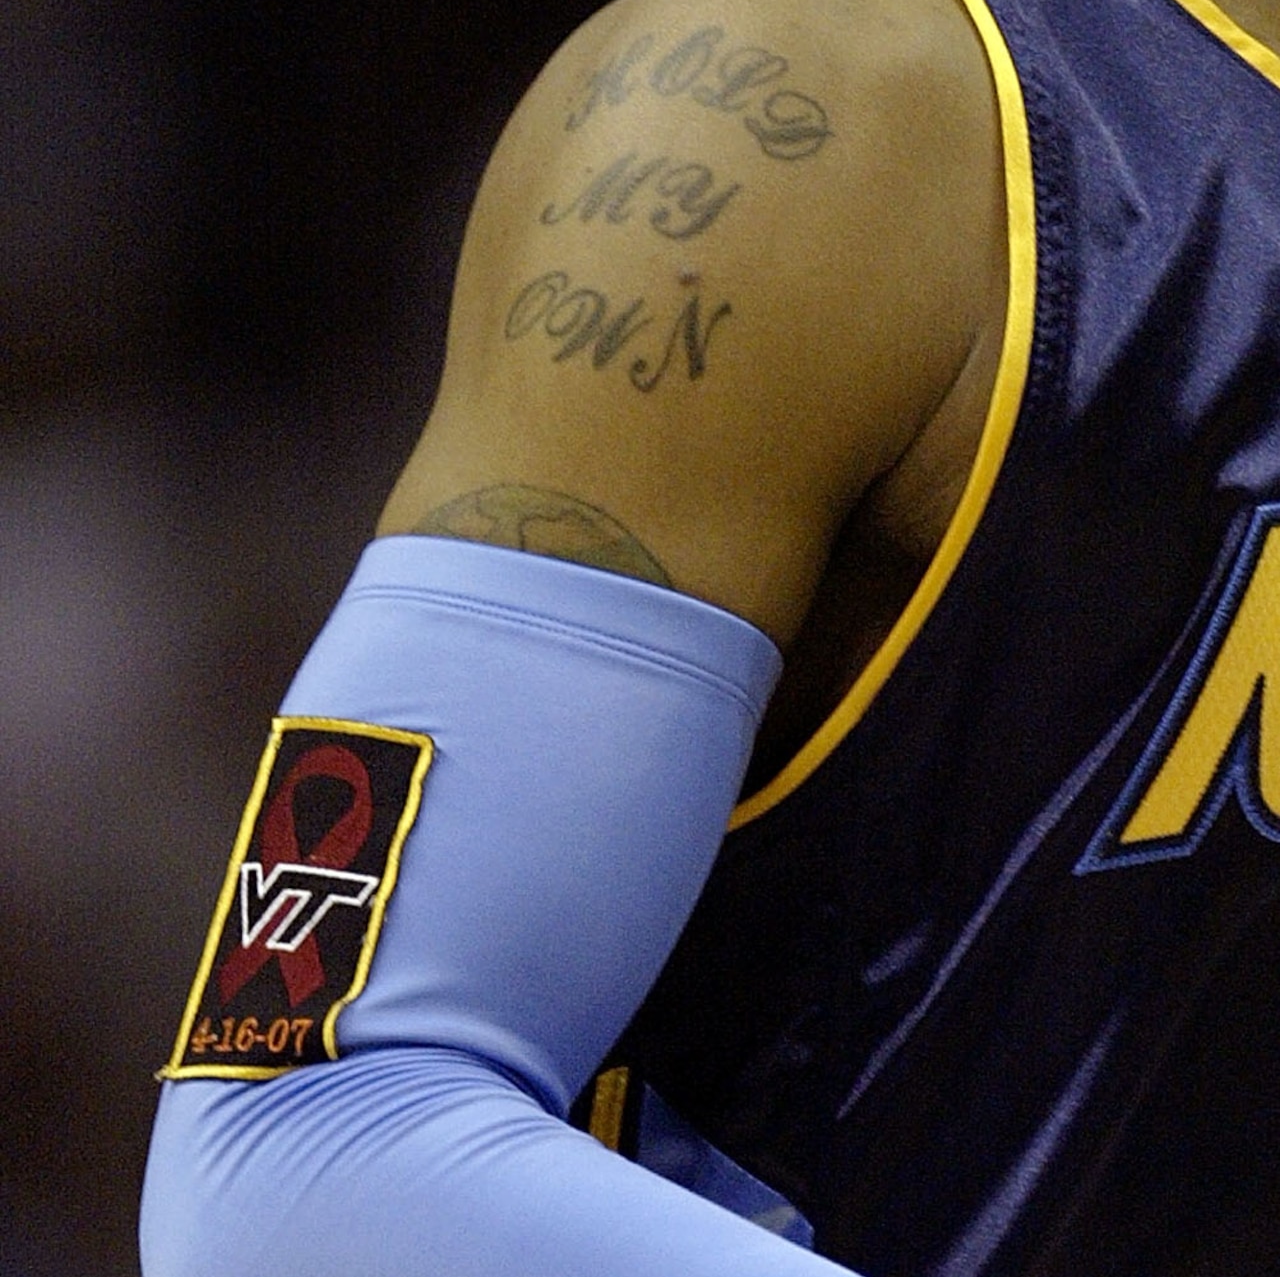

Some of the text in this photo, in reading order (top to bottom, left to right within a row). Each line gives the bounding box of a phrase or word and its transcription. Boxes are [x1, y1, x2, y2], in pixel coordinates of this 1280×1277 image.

[565, 28, 835, 161] HOLD
[540, 154, 742, 241] MY
[505, 271, 734, 393] OWN
[240, 862, 380, 951] VT
